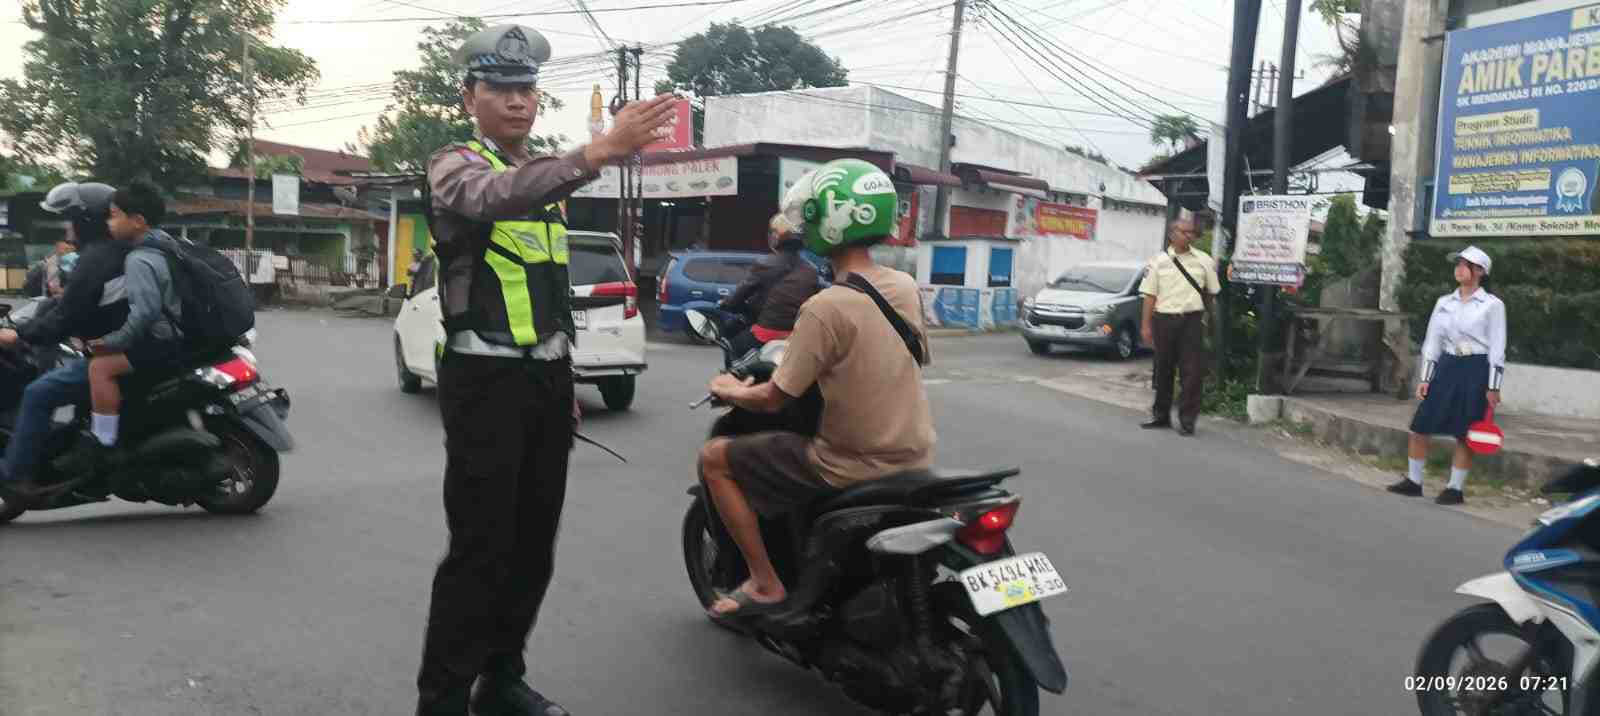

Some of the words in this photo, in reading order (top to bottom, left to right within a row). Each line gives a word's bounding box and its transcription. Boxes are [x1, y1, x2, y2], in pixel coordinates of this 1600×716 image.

[1458, 57, 1524, 95] AMIK
[1457, 117, 1500, 131] Program
[1256, 199, 1307, 209] BRISTHON
[966, 572, 989, 592] BK
